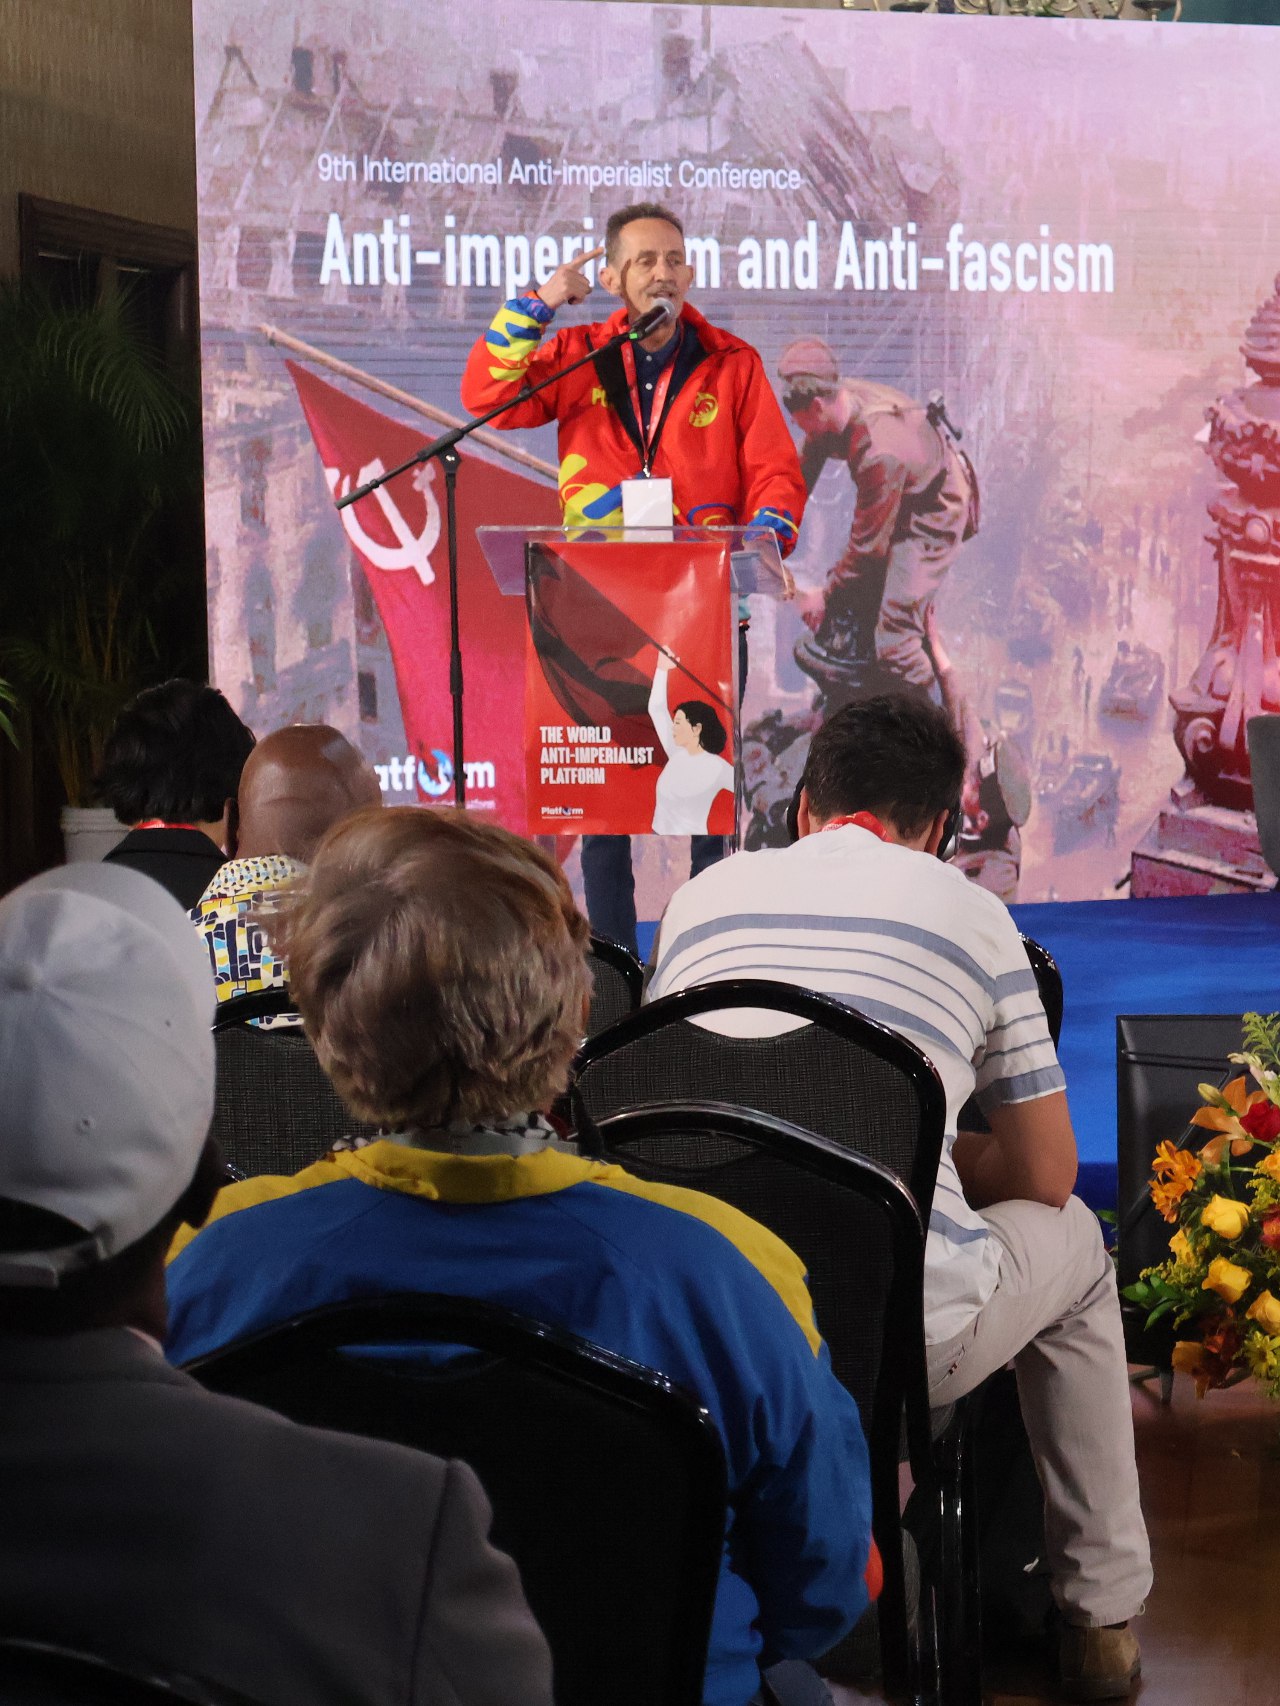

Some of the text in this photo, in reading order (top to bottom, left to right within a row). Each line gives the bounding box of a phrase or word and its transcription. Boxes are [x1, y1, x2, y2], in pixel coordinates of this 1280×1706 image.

[317, 153, 801, 192] 9th International Anti-imperialist Conference
[319, 213, 1114, 301] Anti-imperim and Anti-fascism
[540, 726, 611, 743] THE WORLD
[540, 747, 654, 764] ANTI-IMPERIALIST
[540, 767, 605, 785] PLATFORM
